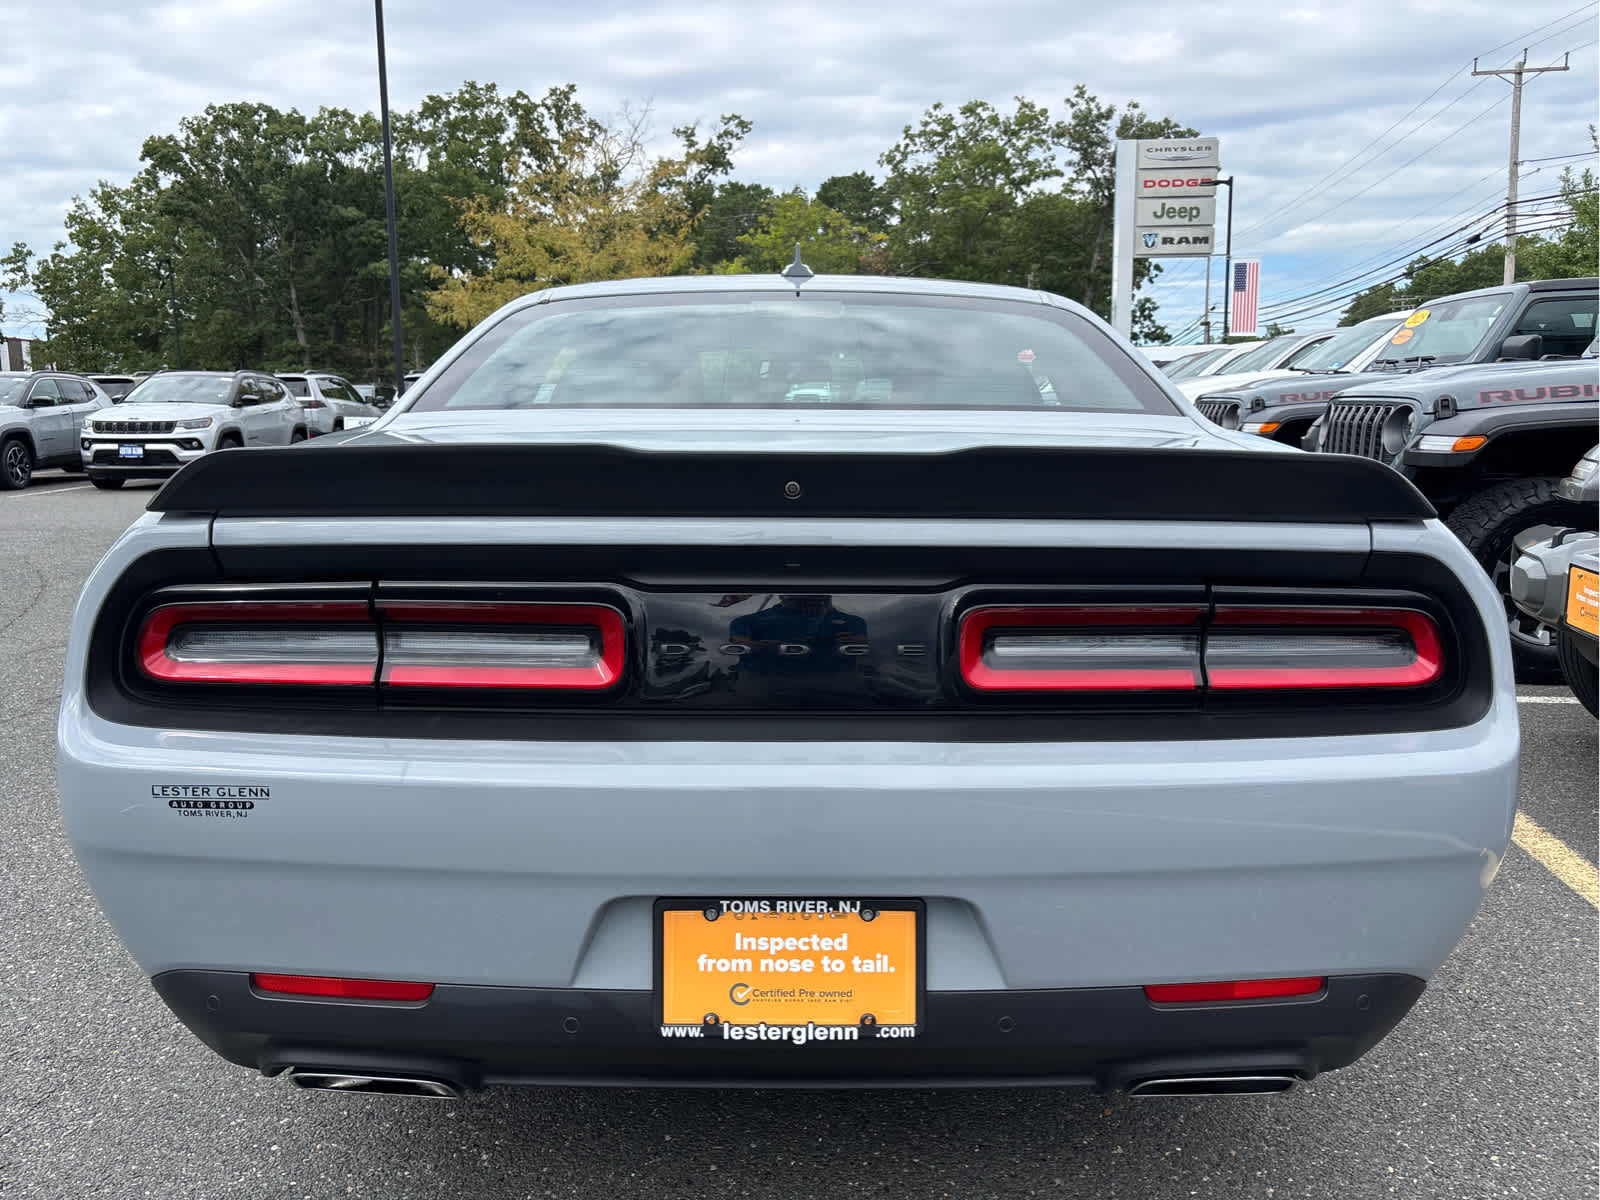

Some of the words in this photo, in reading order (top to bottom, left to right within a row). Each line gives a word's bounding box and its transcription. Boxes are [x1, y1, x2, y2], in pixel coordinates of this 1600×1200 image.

[1146, 145, 1212, 153] CHRYSLER
[1152, 202, 1200, 221] Jeep
[1161, 236, 1209, 245] RAM
[1479, 384, 1599, 403] RUBI
[660, 644, 927, 656] DODGE
[152, 786, 210, 797] LESTER
[216, 787, 270, 798] GLENN
[210, 801, 252, 809] GROUP
[237, 810, 248, 818] NJ
[720, 900, 771, 913] TOMS
[776, 900, 834, 914] RIVER,
[838, 900, 861, 913] NJ
[735, 933, 848, 955] Inspected
[697, 954, 752, 972] from
[760, 957, 814, 972] nose
[821, 956, 845, 972] to
[852, 954, 896, 973] tail.
[752, 989, 796, 998] Certified
[799, 989, 816, 998] Pre
[819, 989, 853, 998] owned
[661, 1026, 704, 1038] www.
[723, 1023, 859, 1044] lesterglenn
[876, 1026, 915, 1038] .com
